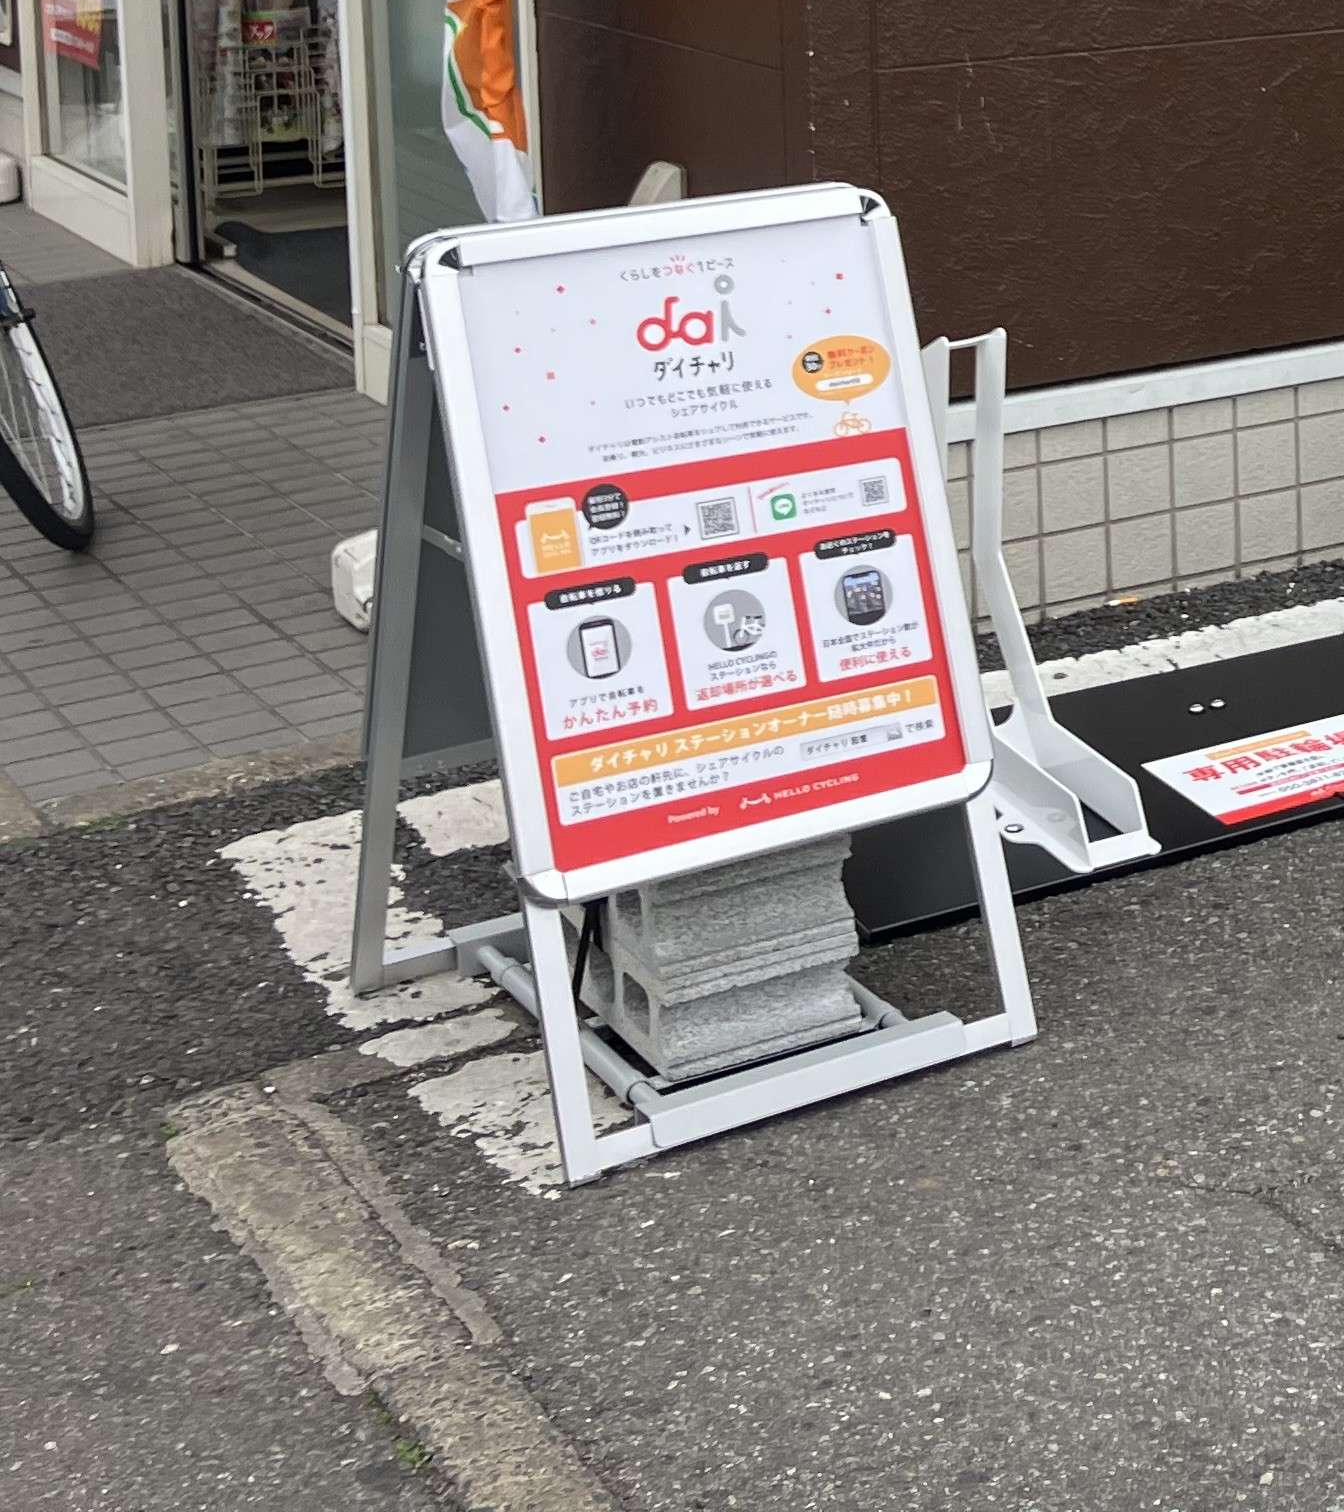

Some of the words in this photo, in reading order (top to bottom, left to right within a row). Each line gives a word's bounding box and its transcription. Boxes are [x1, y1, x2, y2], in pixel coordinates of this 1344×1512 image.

[620, 257, 735, 282] くらしをつなぐ1ピース
[637, 274, 747, 352] dai
[653, 351, 735, 382] ダイチャリ
[625, 378, 772, 410] いつでもどこでも気軽に使える
[671, 399, 738, 418] シェアサイクル
[710, 660, 777, 681] ステーションなら
[839, 647, 912, 671] 便利に使える
[569, 685, 644, 708] アプリで自転車を
[695, 670, 797, 701] 返却場所が選べる
[563, 698, 658, 730] かんたん予約
[590, 742, 669, 772] ダイチャリ
[571, 772, 729, 817] ステーションを置きませんか？
[774, 785, 811, 801] HELLO
[812, 773, 860, 791] CYCLING
